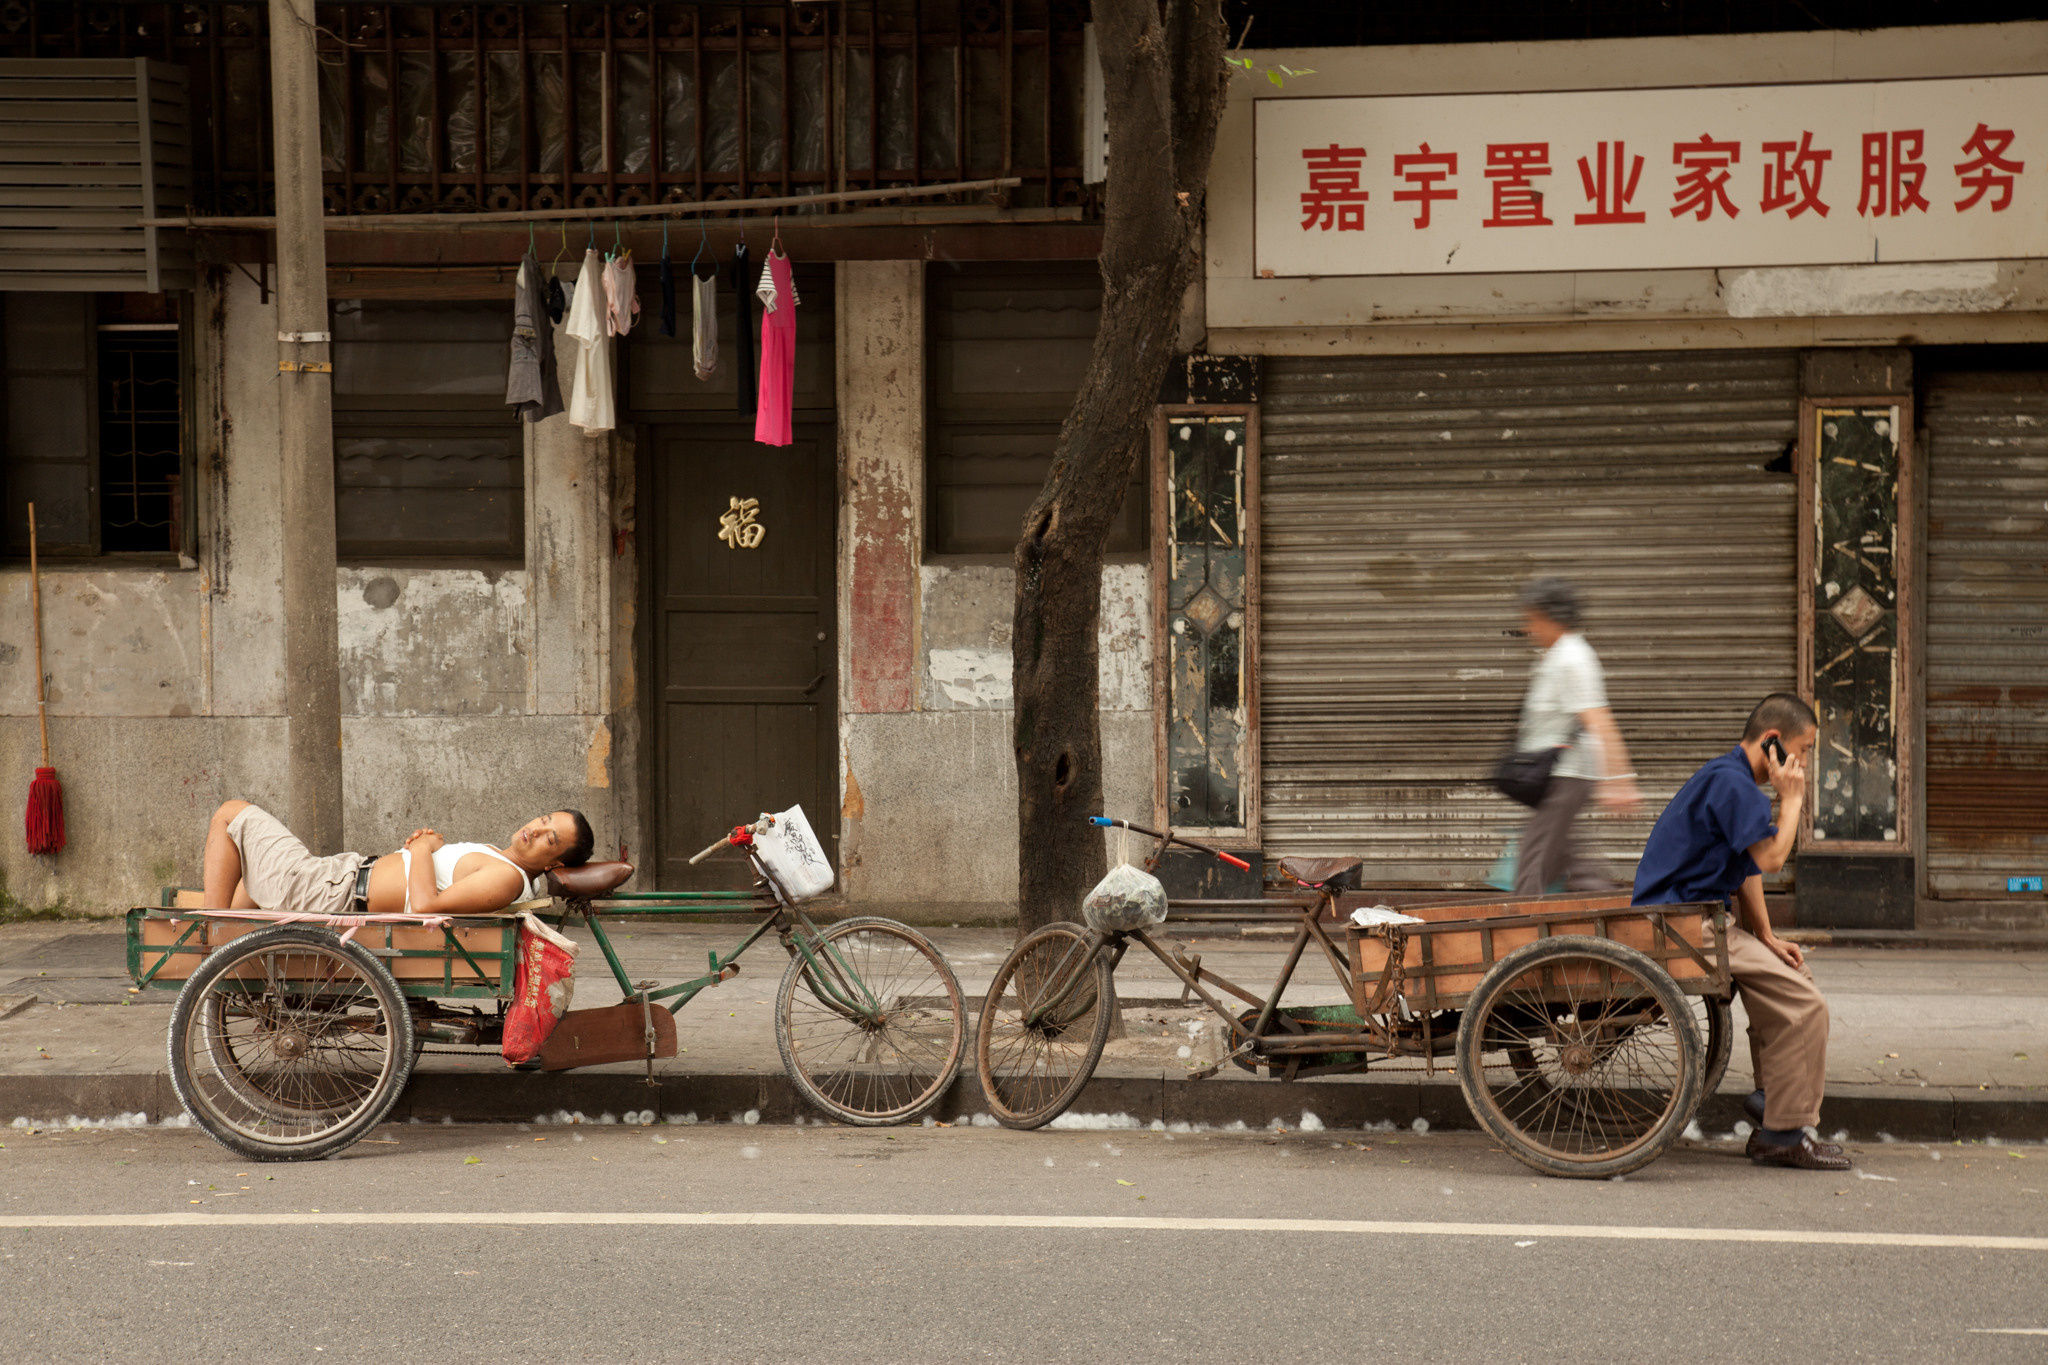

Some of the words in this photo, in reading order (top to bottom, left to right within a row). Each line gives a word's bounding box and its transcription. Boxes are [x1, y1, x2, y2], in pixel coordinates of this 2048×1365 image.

[1300, 123, 2024, 231] 嘉宇置业家政服务
[718, 496, 765, 548] 福
